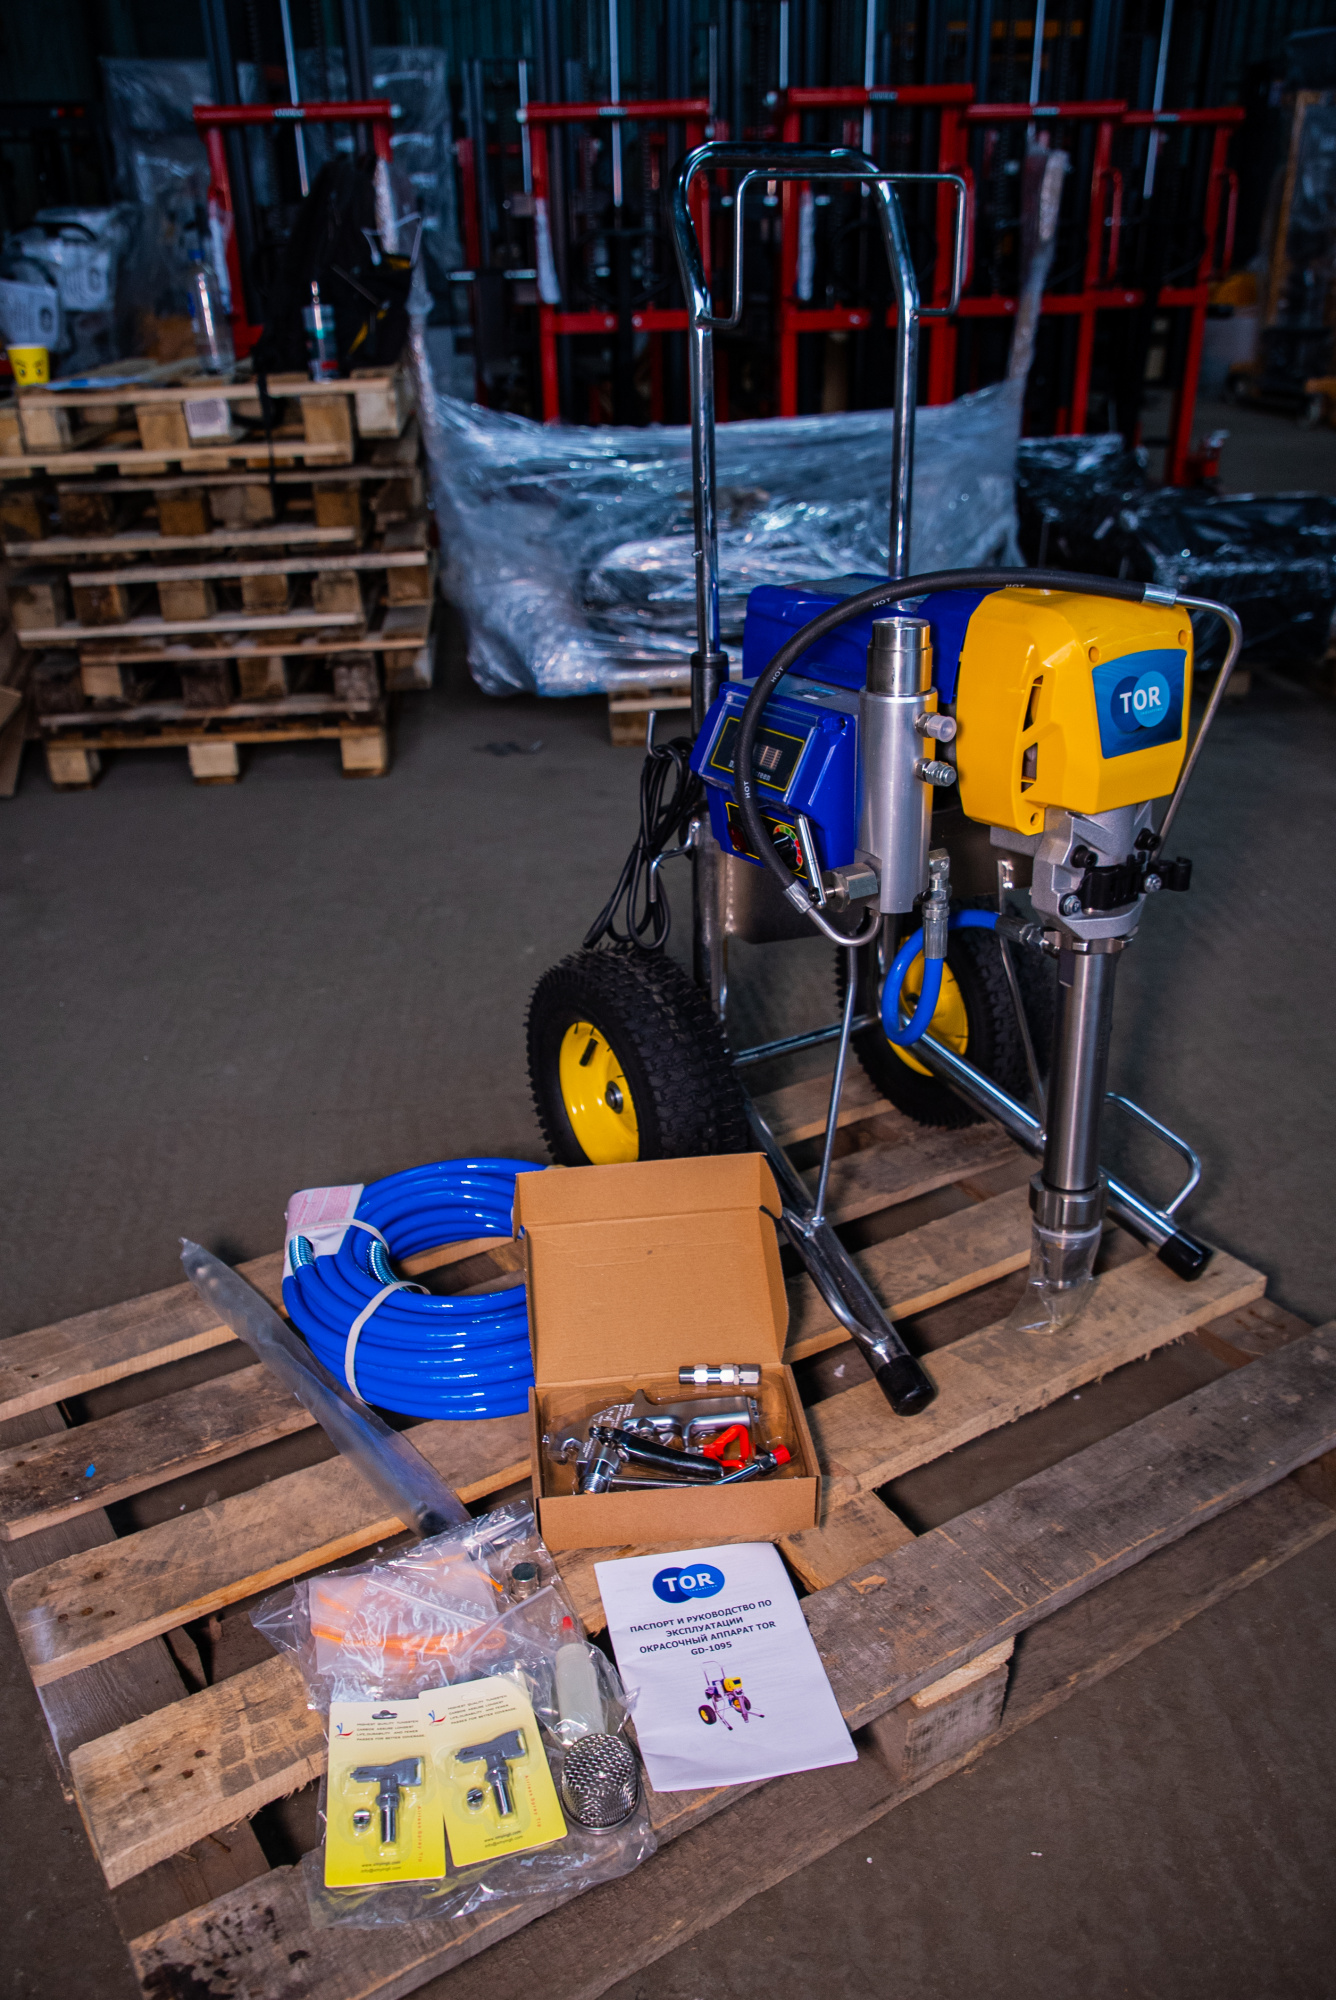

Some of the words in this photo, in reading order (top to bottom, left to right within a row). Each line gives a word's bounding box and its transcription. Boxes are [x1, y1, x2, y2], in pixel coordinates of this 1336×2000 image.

[872, 598, 891, 607] HOT
[770, 665, 784, 683] HOT
[1120, 686, 1161, 714] TOR
[662, 1572, 715, 1592] TOR
[630, 1619, 675, 1633] ПАСПОРТ
[687, 1604, 756, 1623] РУКОВОДСТВО
[758, 1599, 773, 1608] ПО
[666, 1617, 744, 1638] ЭКСПЛУАТАЦИИ
[639, 1633, 708, 1654] ОКРАСОЧНЫЙ
[710, 1625, 755, 1641] АППАРАТ
[691, 1641, 733, 1656] GD-1095
